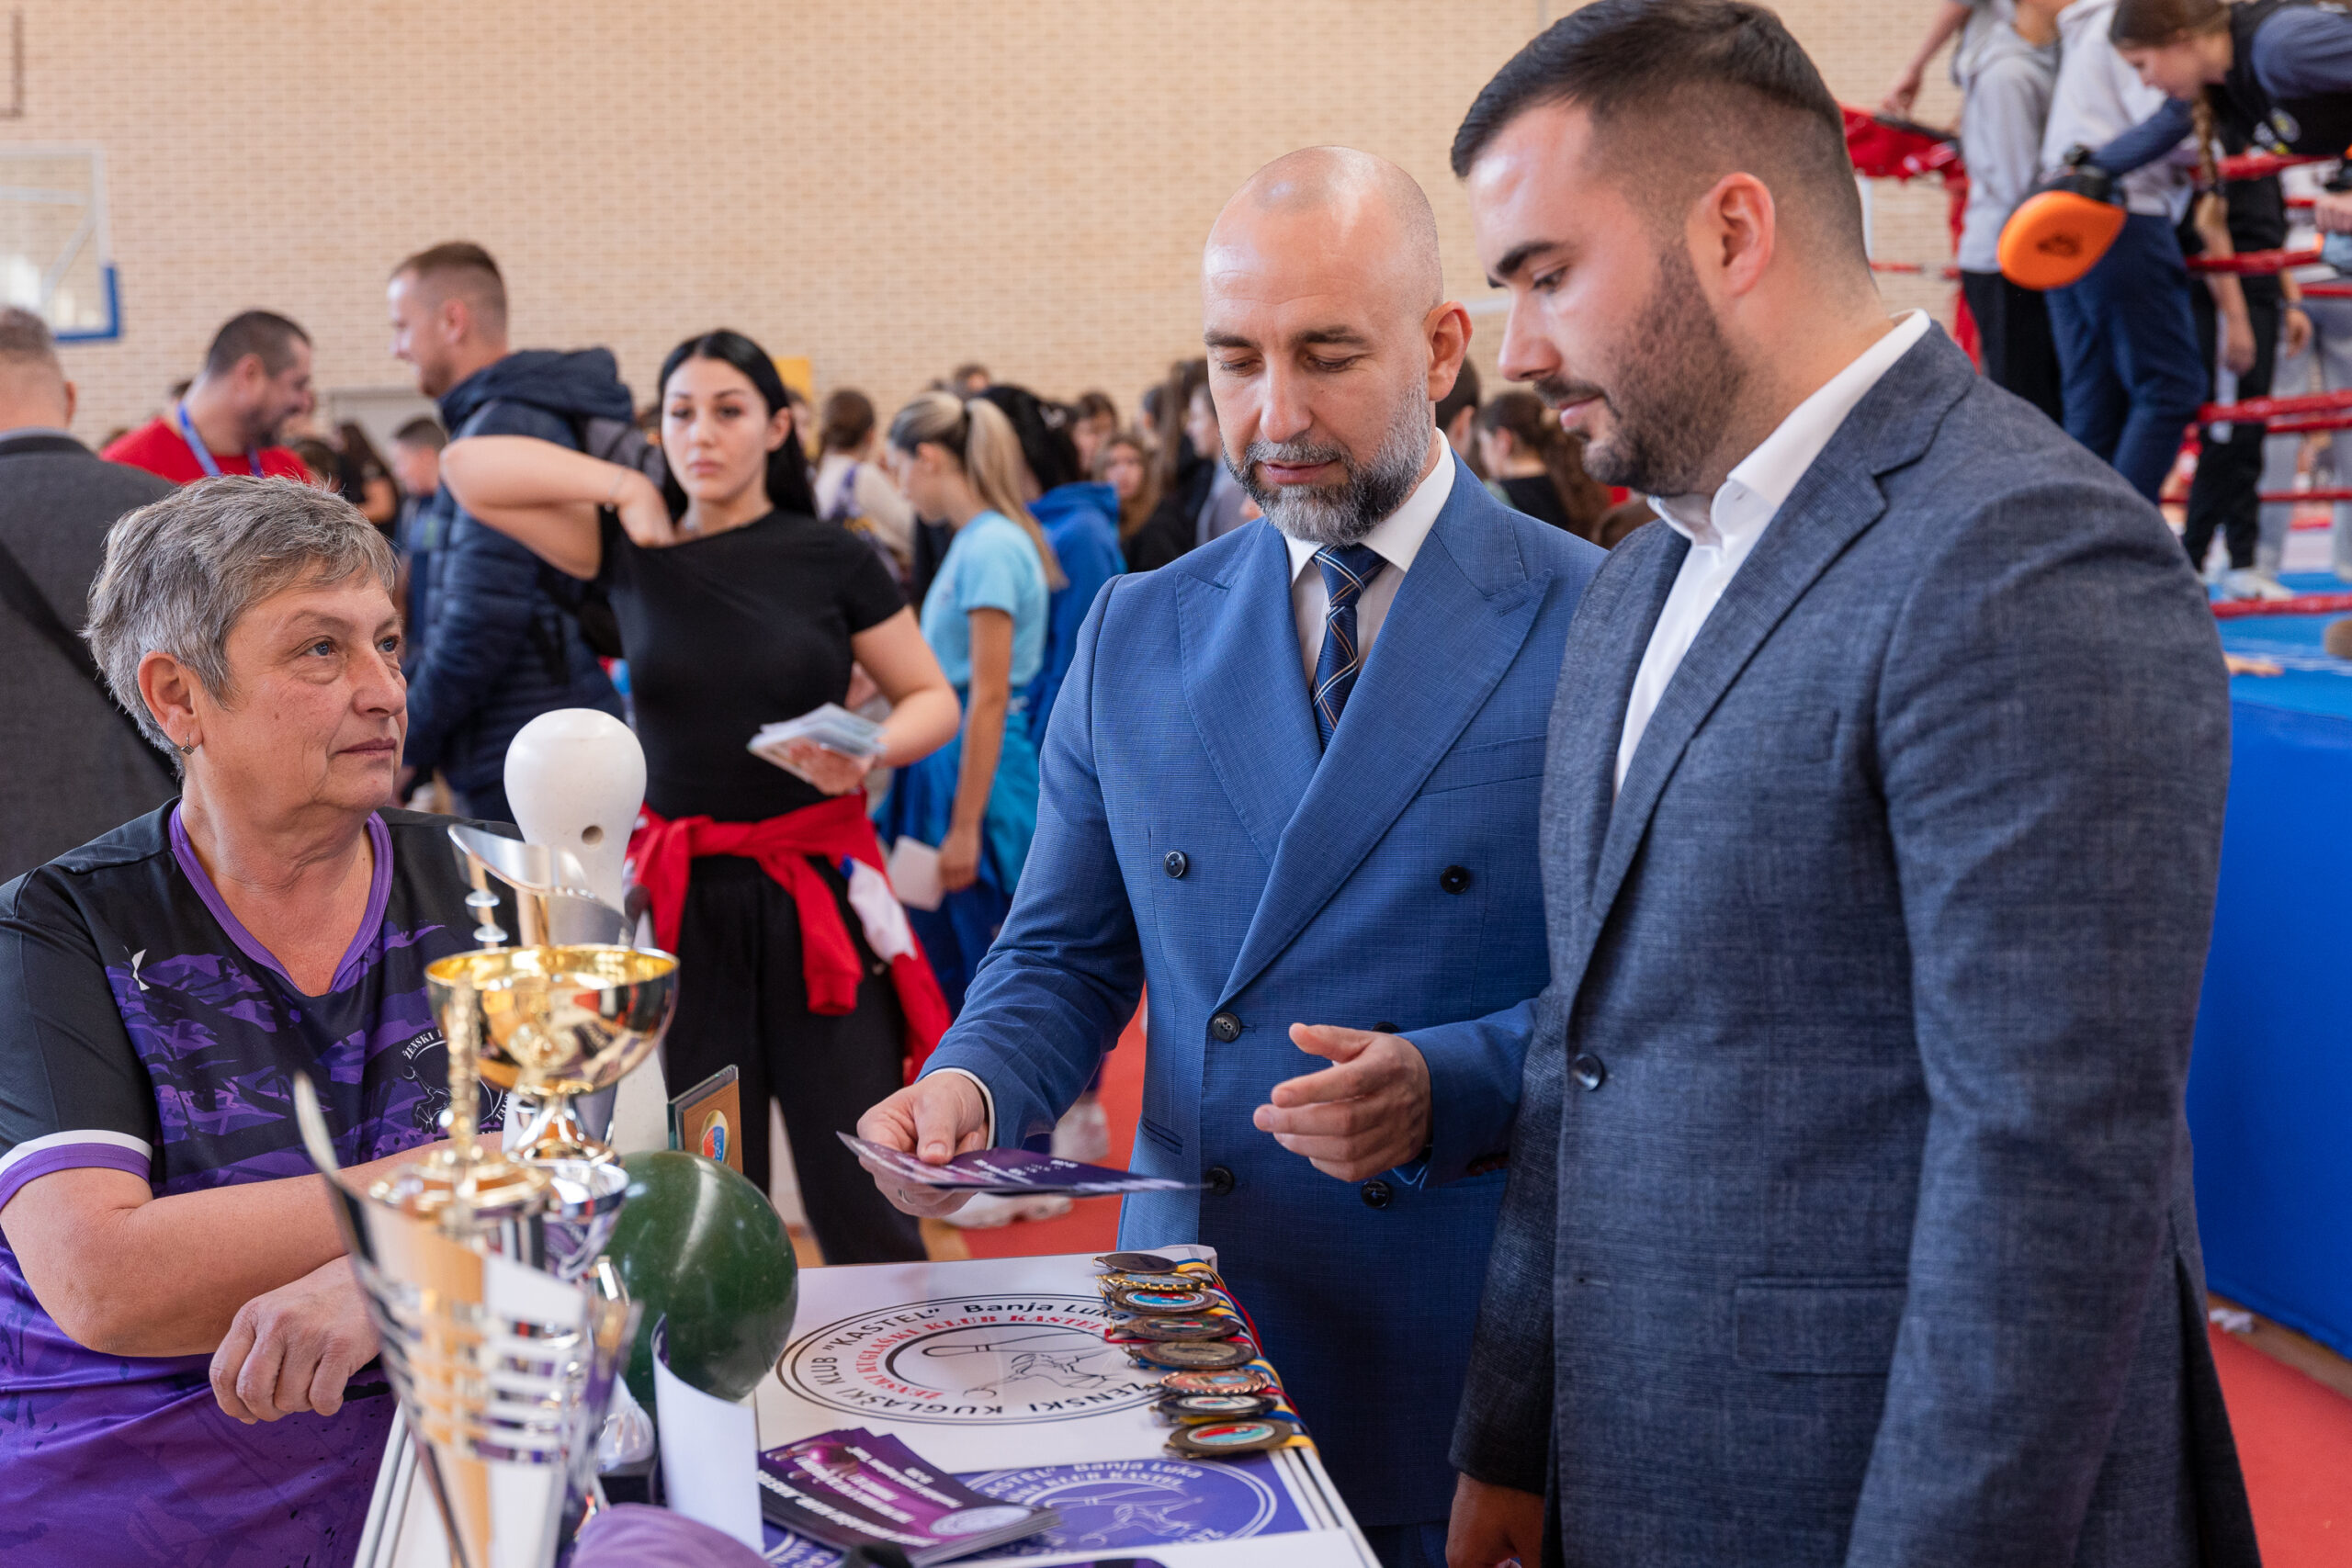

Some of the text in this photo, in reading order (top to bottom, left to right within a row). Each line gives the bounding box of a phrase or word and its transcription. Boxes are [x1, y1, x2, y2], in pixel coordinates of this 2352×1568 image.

[401, 1032, 435, 1060] ŽENSKI
[923, 1315, 998, 1331] KLUB
[1010, 1314, 1104, 1331] KASTEL
[810, 1357, 846, 1386] KLUB
[964, 1303, 1053, 1314] Banja
[1064, 1304, 1129, 1321] Luka
[1073, 1461, 1144, 1472] Banja
[1150, 1462, 1204, 1479] Luka
